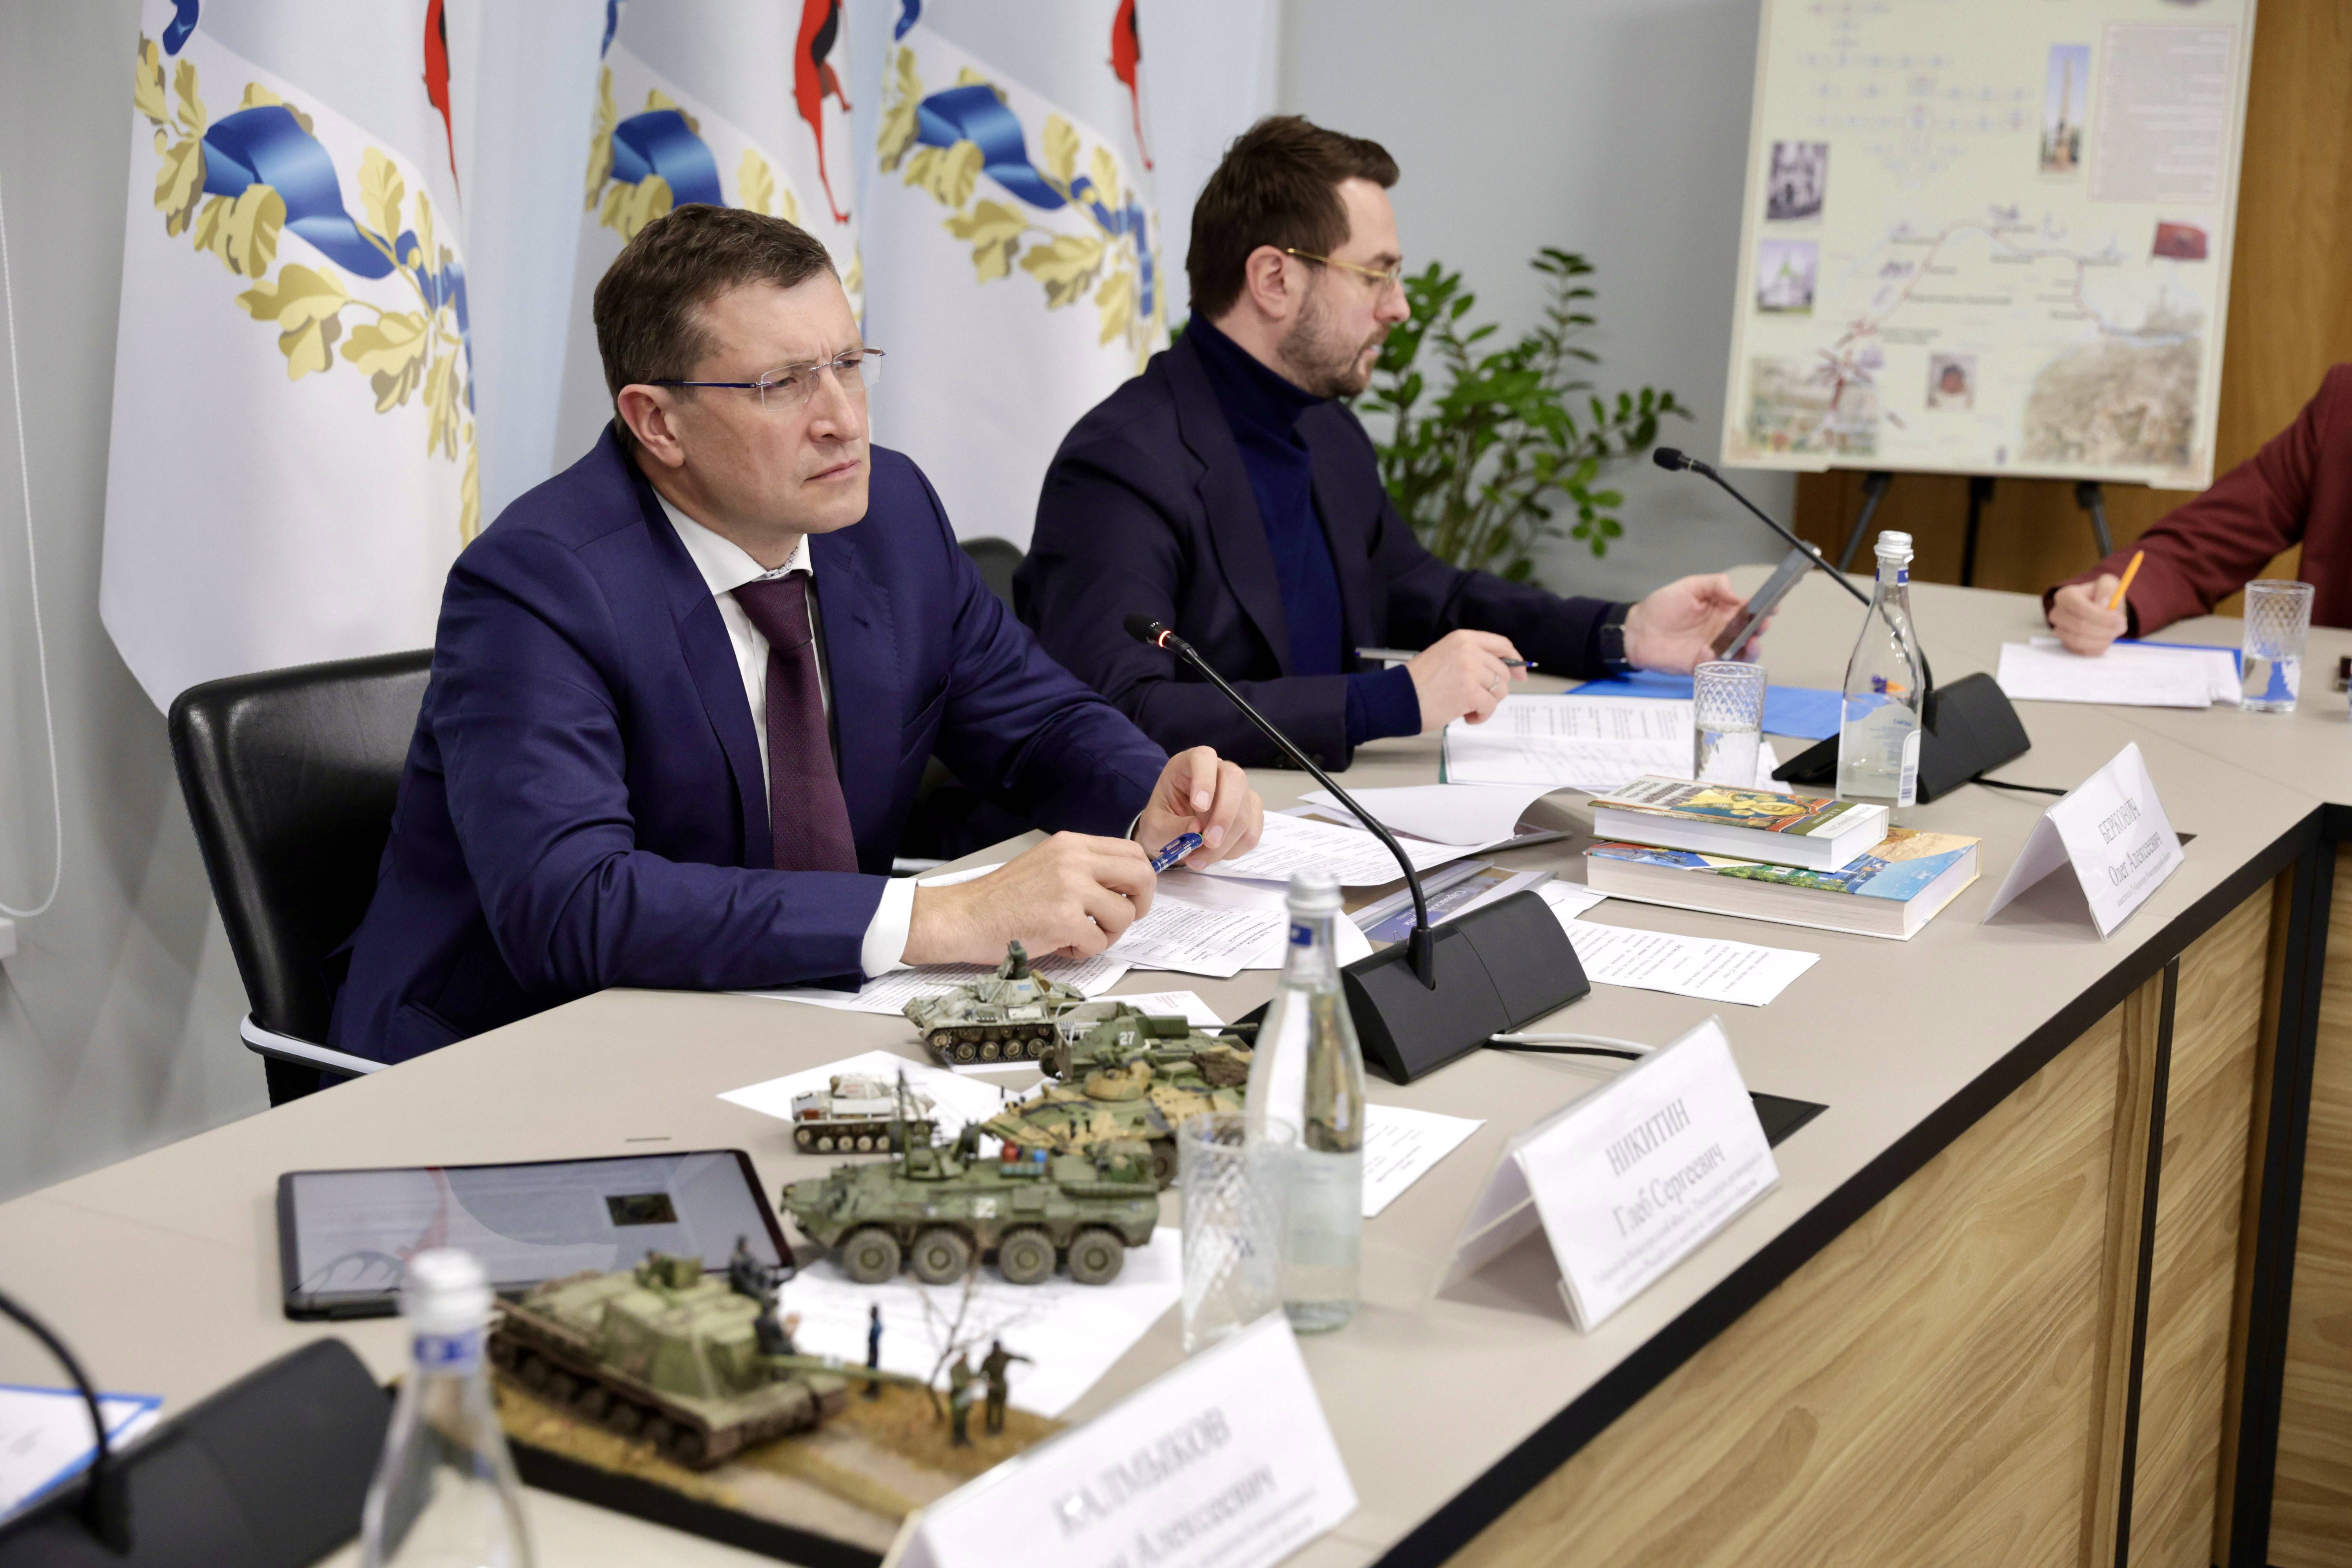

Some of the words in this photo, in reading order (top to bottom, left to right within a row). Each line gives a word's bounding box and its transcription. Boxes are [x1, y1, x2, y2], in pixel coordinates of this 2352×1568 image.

[2098, 797, 2140, 844] БЕРКОВИЧ
[2108, 862, 2129, 886] Олег
[1119, 1031, 1135, 1046] 27
[1605, 1098, 1690, 1176] НИКИТИН
[1613, 1188, 1653, 1237] Глеб
[1649, 1144, 1725, 1211] Сергеевич
[1051, 1406, 1231, 1539] КАЛМЫКОВ
